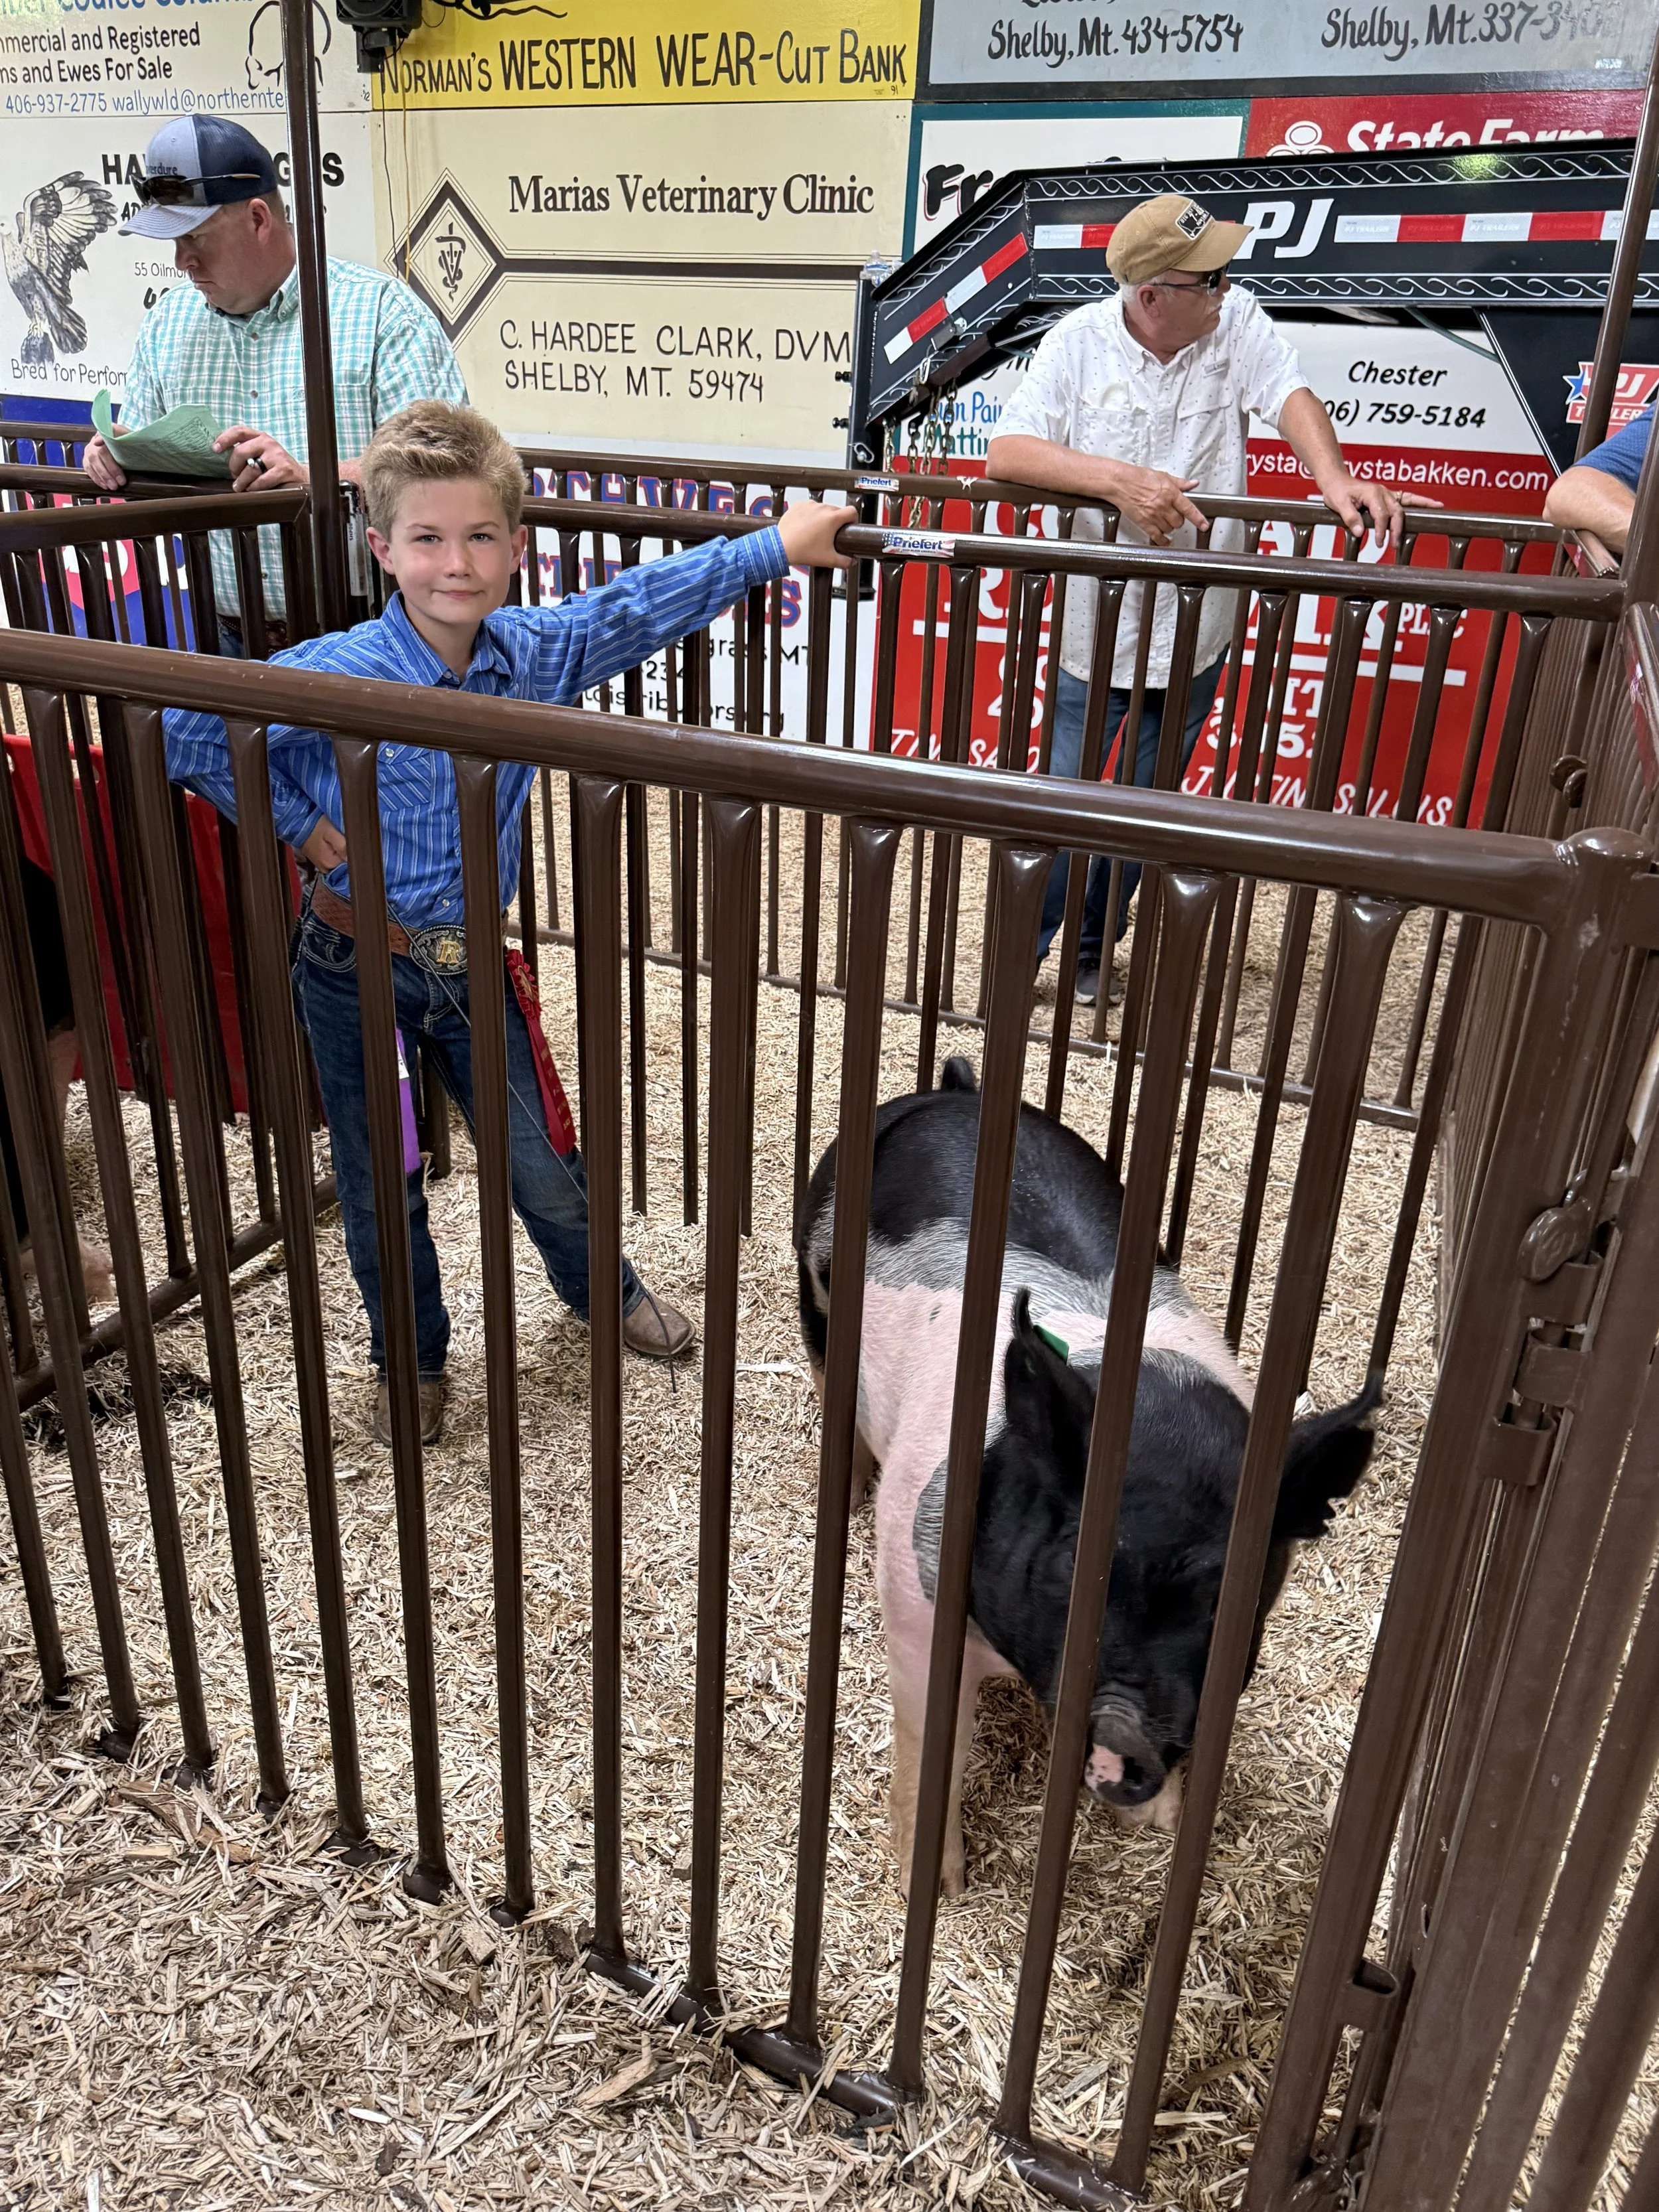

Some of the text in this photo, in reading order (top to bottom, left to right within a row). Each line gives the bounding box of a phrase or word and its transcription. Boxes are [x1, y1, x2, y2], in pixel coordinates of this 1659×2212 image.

[71, 25, 103, 51] and
[108, 21, 200, 54] Registered
[987, 14, 1244, 68] Shelby, Mt. 434-5754
[1321, 7, 1419, 62] Shelby,
[1425, 3, 1477, 44] Mt.
[22, 58, 53, 84] and
[57, 60, 101, 82] Ewes
[105, 58, 133, 81] For
[137, 56, 173, 80] Sale
[499, 37, 637, 91] WESTERN
[839, 28, 908, 87] BANK
[6, 92, 107, 114] 406-937-2775
[508, 174, 875, 221] Marias Veterinary Clinic
[1232, 198, 1334, 260] PJ
[135, 262, 147, 276] 55
[500, 319, 851, 364] C. HARDEE CLARK, DVM
[11, 358, 47, 380] Bred
[53, 363, 76, 382] for
[505, 359, 764, 404] SHELBY, MT. 59474
[1348, 360, 1447, 388] Chester
[1366, 402, 1486, 429] 759-5184
[861, 477, 892, 486] Priefert
[893, 536, 943, 550] Priefert
[437, 940, 460, 964] R
